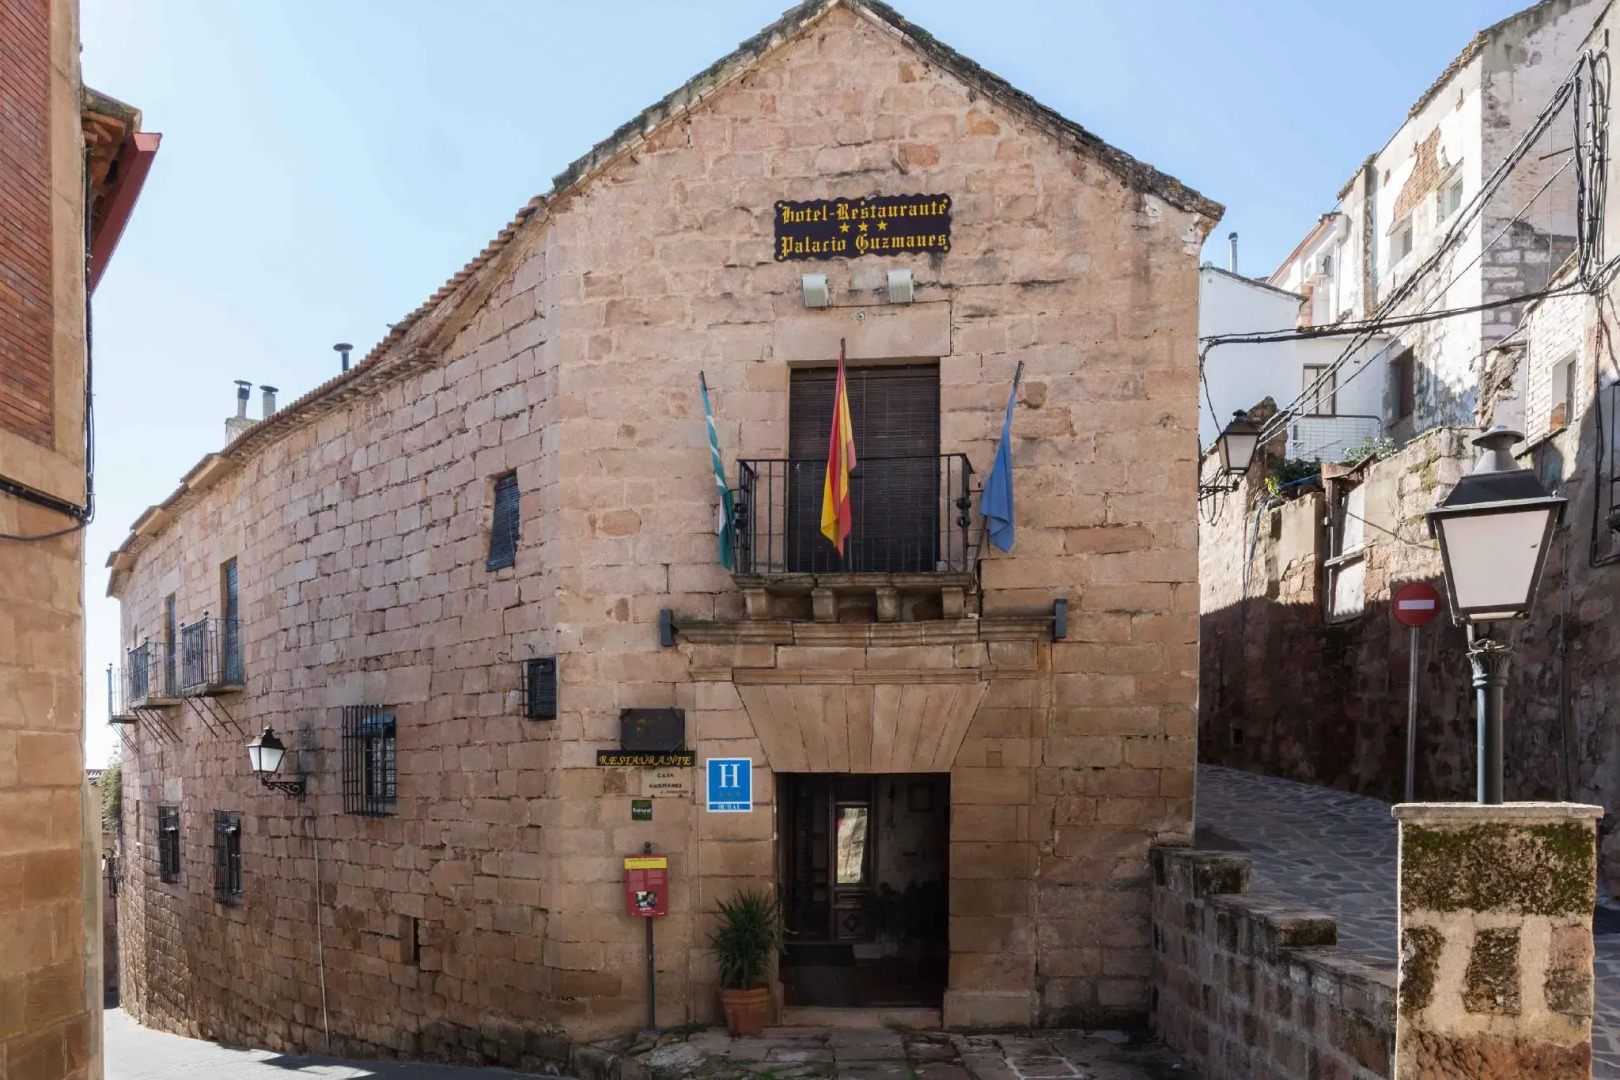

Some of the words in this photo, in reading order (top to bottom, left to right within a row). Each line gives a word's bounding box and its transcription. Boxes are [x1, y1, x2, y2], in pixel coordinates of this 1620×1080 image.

[781, 236, 847, 257] Palacio
[855, 233, 947, 250] Guzmanes
[599, 754, 692, 766] RESTAURANTE
[718, 763, 741, 788] H
